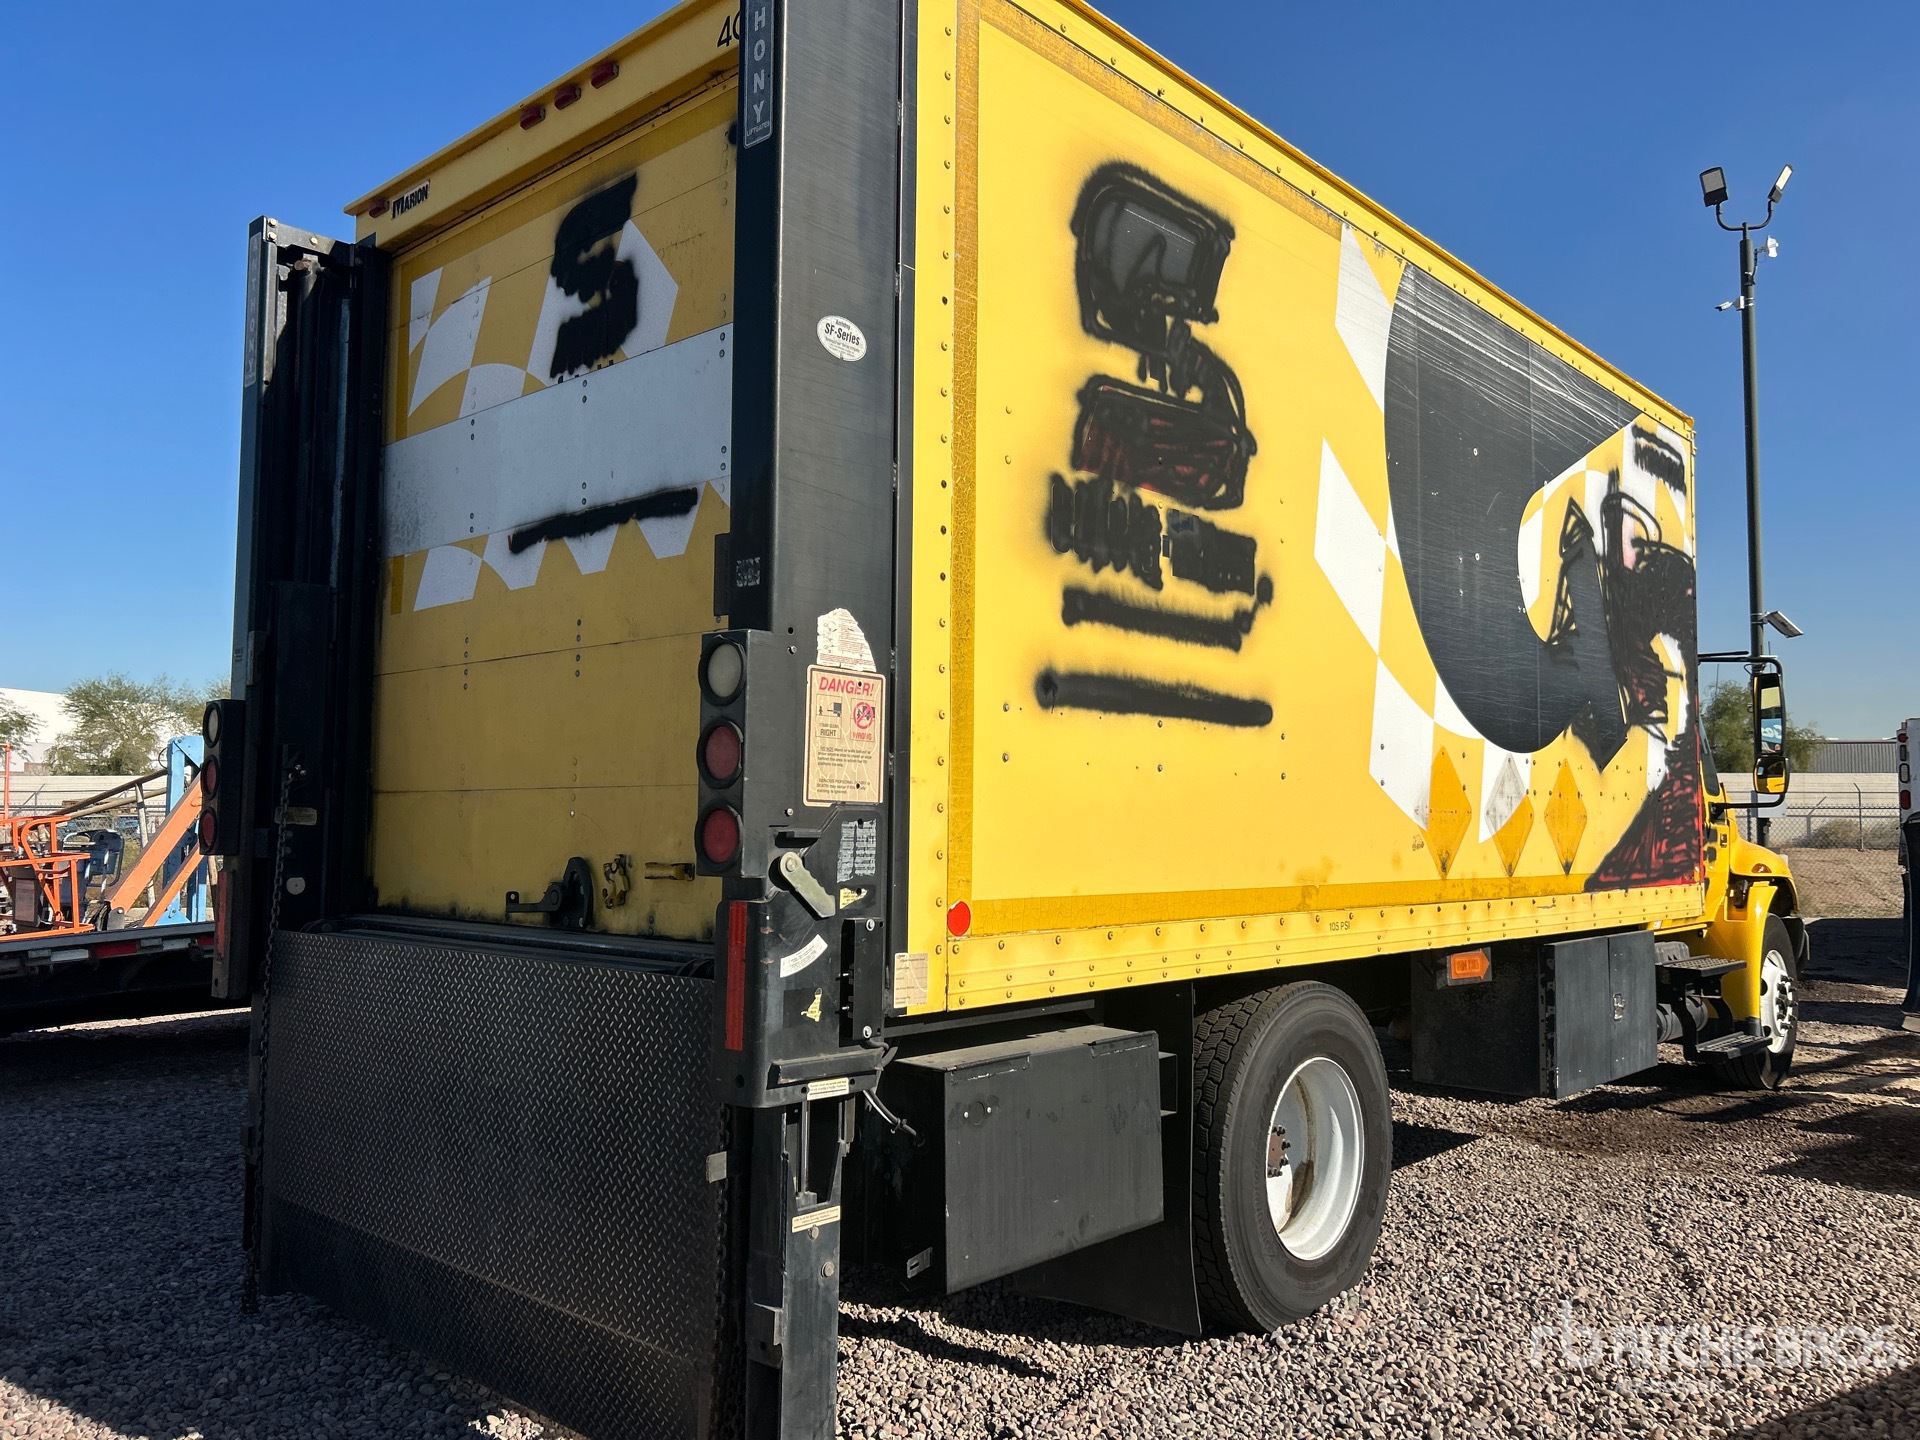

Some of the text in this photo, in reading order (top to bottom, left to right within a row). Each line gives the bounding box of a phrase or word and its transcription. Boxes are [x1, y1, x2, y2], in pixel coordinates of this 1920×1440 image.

[392, 184, 429, 219] MARION
[824, 322, 860, 346] SF-Series
[819, 676, 875, 697] DANGER!
[820, 728, 837, 737] RIGHT
[1329, 921, 1350, 931] 105 PSI
